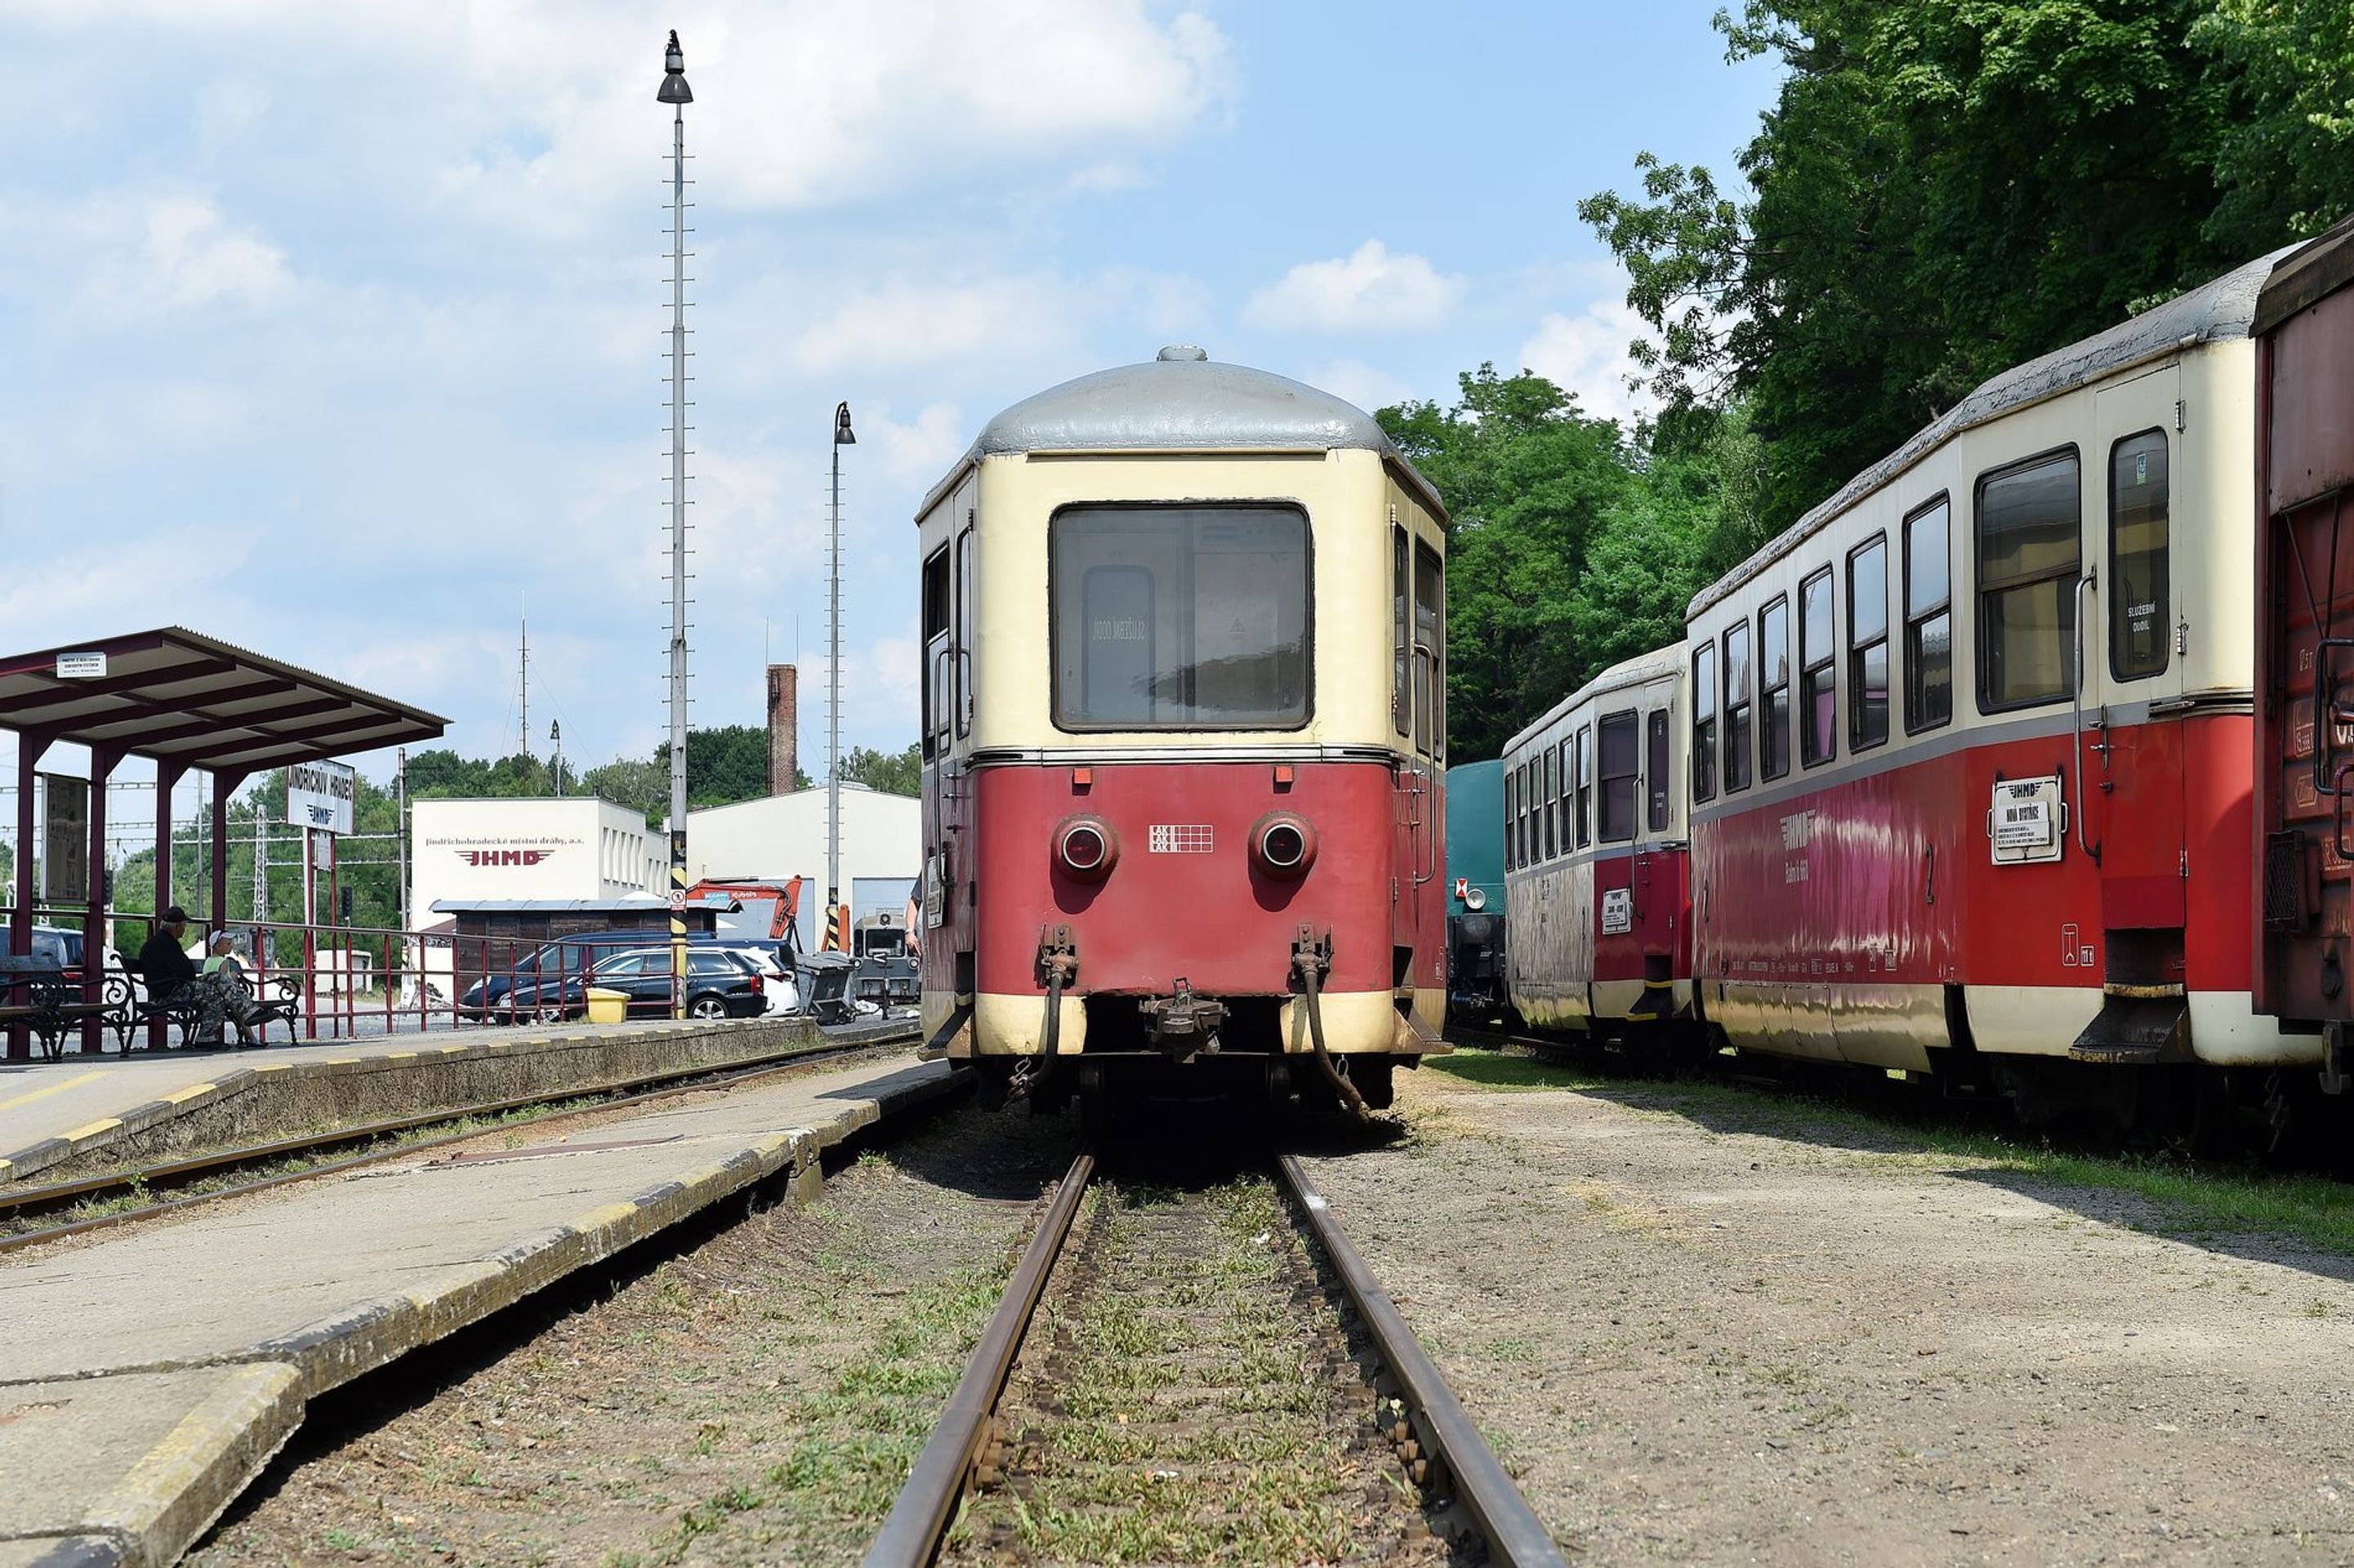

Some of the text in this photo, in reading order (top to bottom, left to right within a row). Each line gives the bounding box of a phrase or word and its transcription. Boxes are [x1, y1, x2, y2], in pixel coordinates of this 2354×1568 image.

[2012, 782, 2035, 798] JHMD
[1149, 826, 1171, 834] LAK
[1149, 843, 1171, 851] LAK
[469, 850, 541, 866] JHMD
